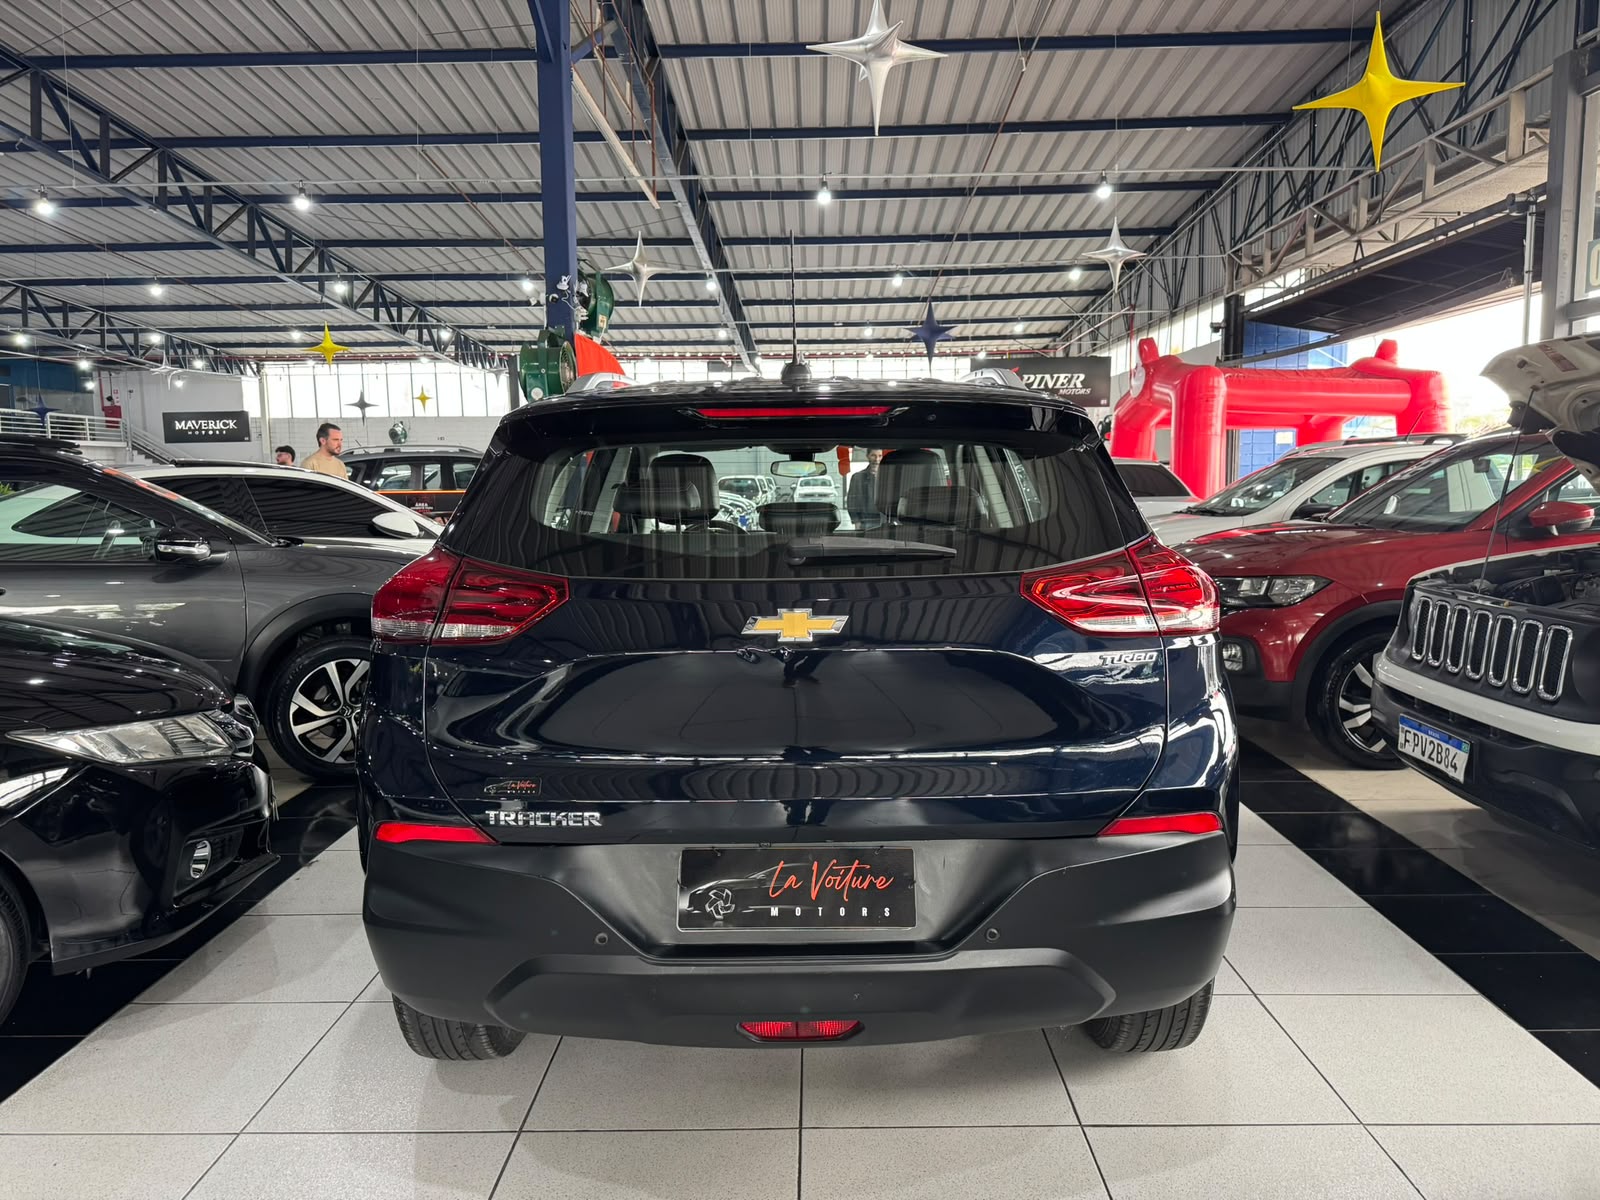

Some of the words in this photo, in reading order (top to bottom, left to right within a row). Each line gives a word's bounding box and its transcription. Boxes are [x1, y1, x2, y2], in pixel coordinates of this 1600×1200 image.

[175, 420, 237, 430] MAVERICK
[1100, 651, 1158, 667] TURBO
[1403, 729, 1458, 774] FPV2B84
[485, 810, 603, 827] TRACKER
[768, 860, 803, 898] La
[810, 859, 894, 902] Voiture
[770, 906, 891, 917] MOTORS
